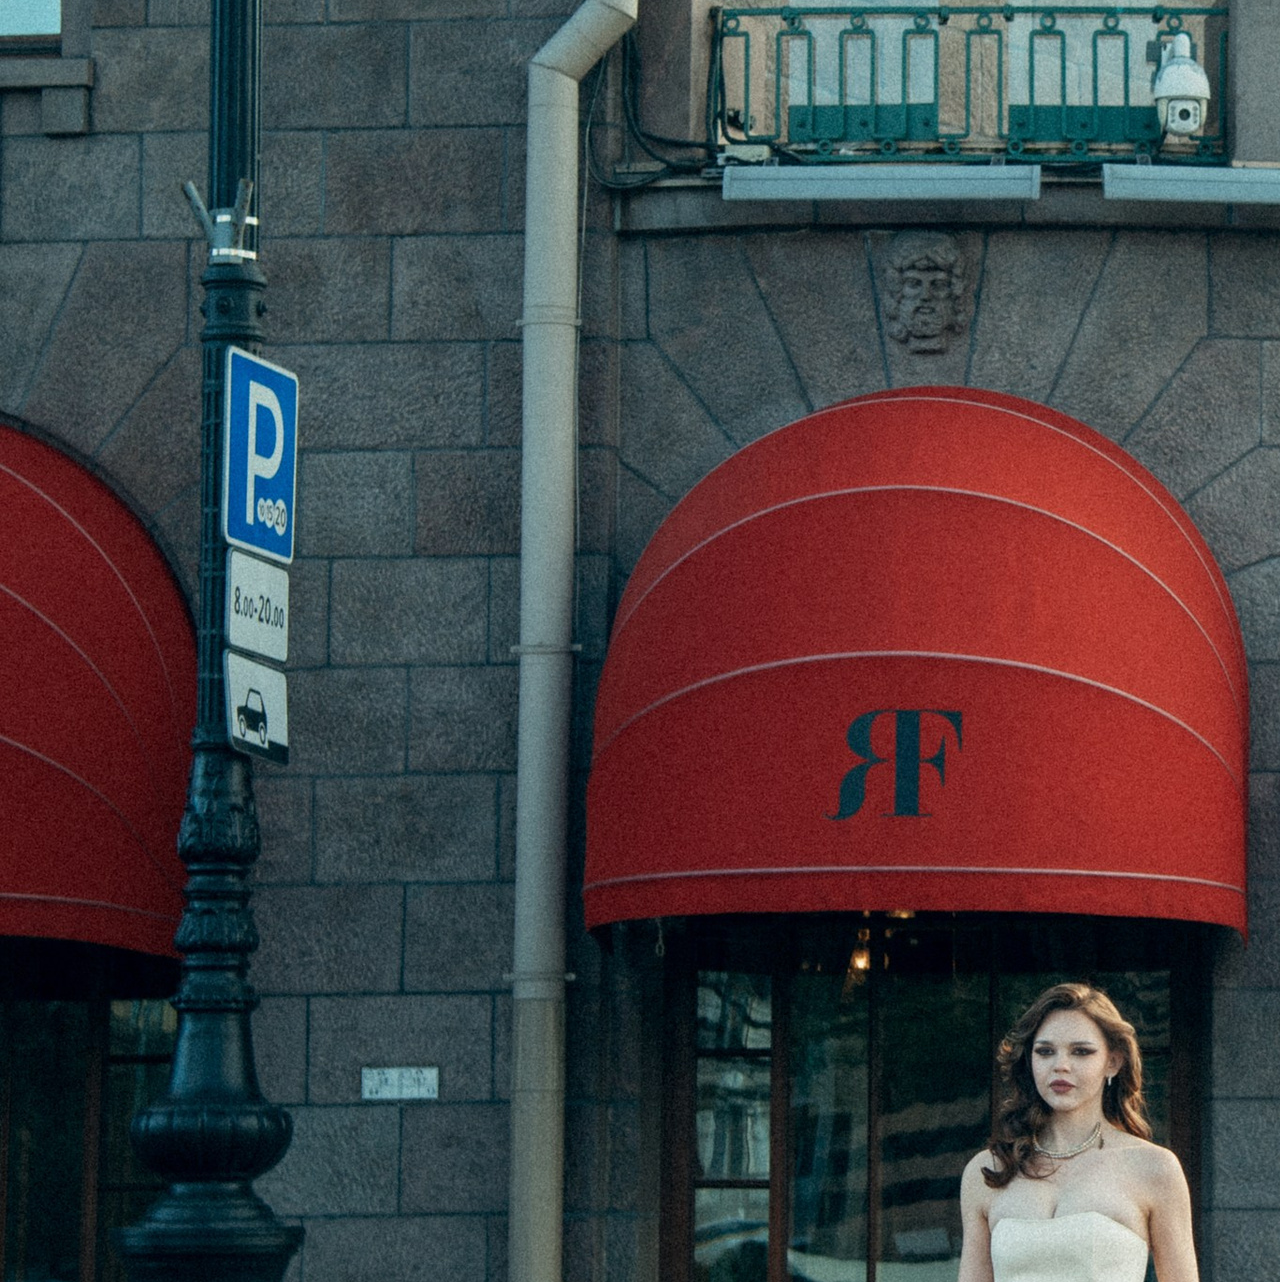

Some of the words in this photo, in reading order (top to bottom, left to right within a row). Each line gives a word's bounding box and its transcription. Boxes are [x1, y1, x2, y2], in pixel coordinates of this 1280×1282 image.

[246, 380, 284, 525] P
[275, 506, 286, 528] 20
[234, 585, 285, 629] 8.00-20.00
